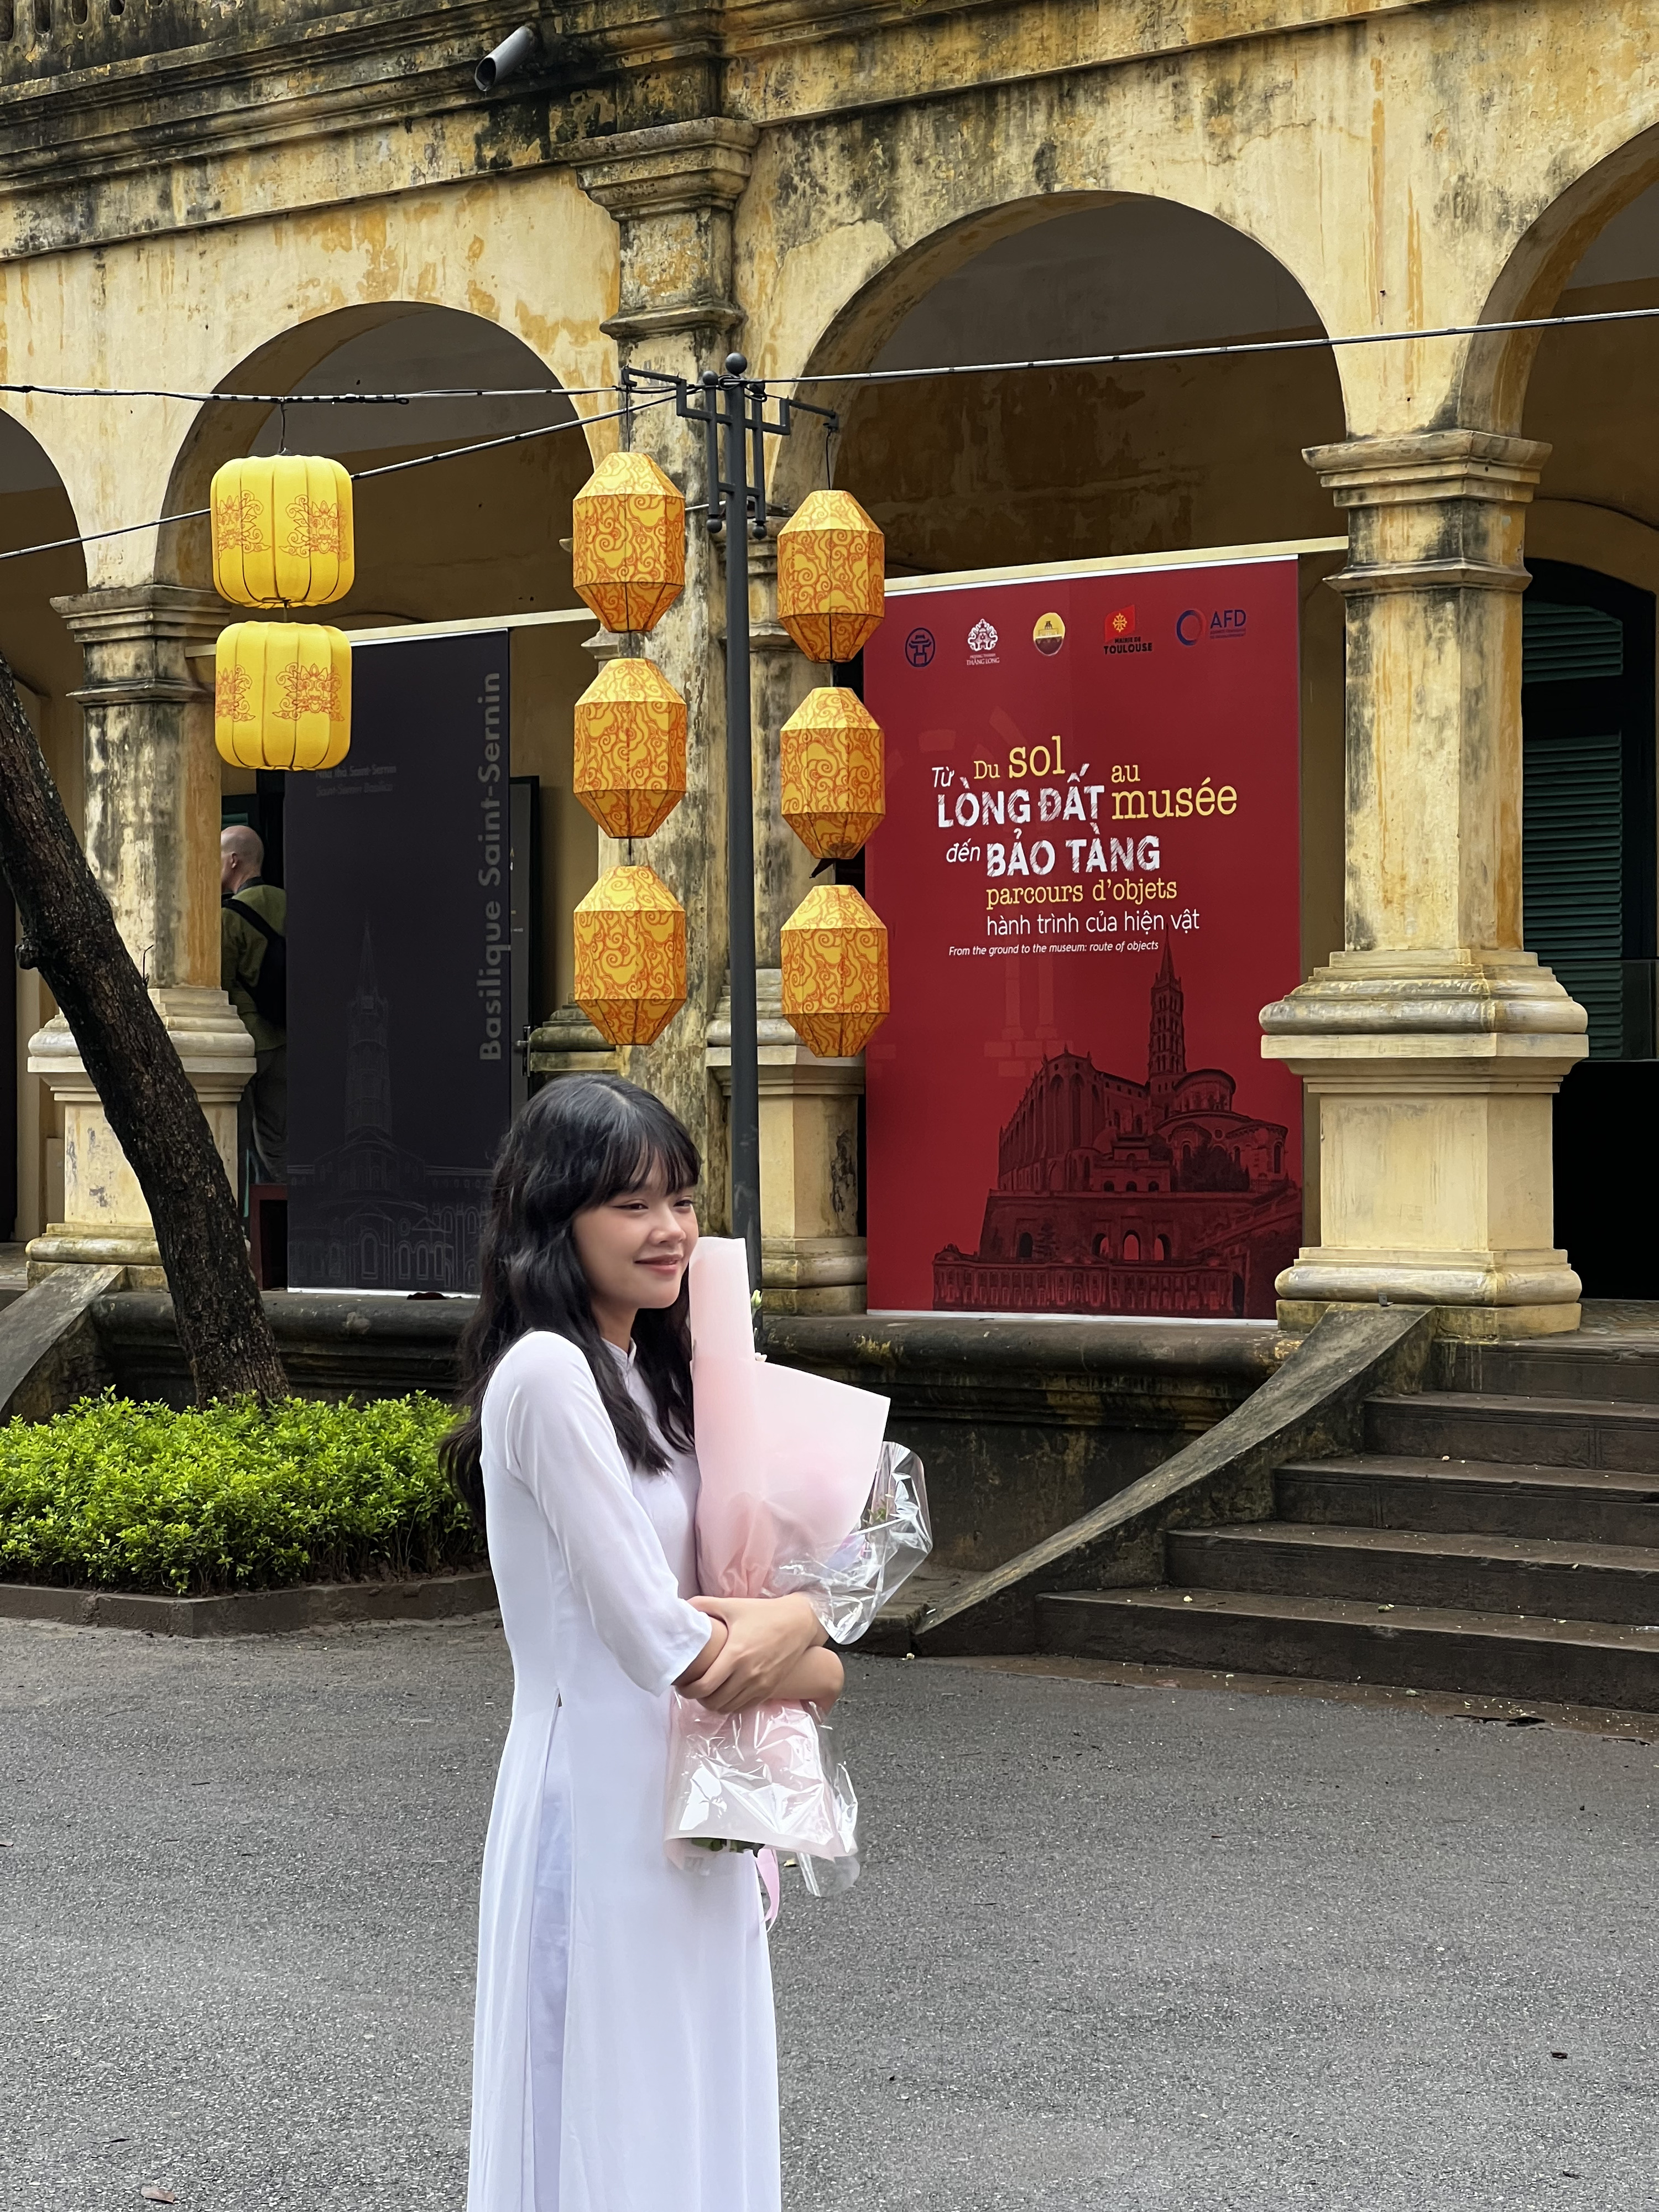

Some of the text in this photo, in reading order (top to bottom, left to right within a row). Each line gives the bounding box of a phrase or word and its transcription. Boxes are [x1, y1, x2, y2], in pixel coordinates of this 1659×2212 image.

[1210, 609, 1246, 629] AFD
[1103, 643, 1152, 655] TOULOUSE
[973, 735, 1066, 779] Du sol
[931, 766, 955, 788] Từ
[1111, 764, 1141, 783] au
[937, 763, 1105, 828] LÒNG ĐẤT
[1111, 778, 1238, 820] musée
[946, 822, 1160, 878] đến BẢO TÀNG
[477, 672, 511, 1060] Basilique Saint-Sernin
[985, 877, 1177, 910] parcours d'objets
[987, 909, 1200, 938] hành trình của hiện vật
[948, 940, 1159, 957] From the ground to the museum: route of objects
